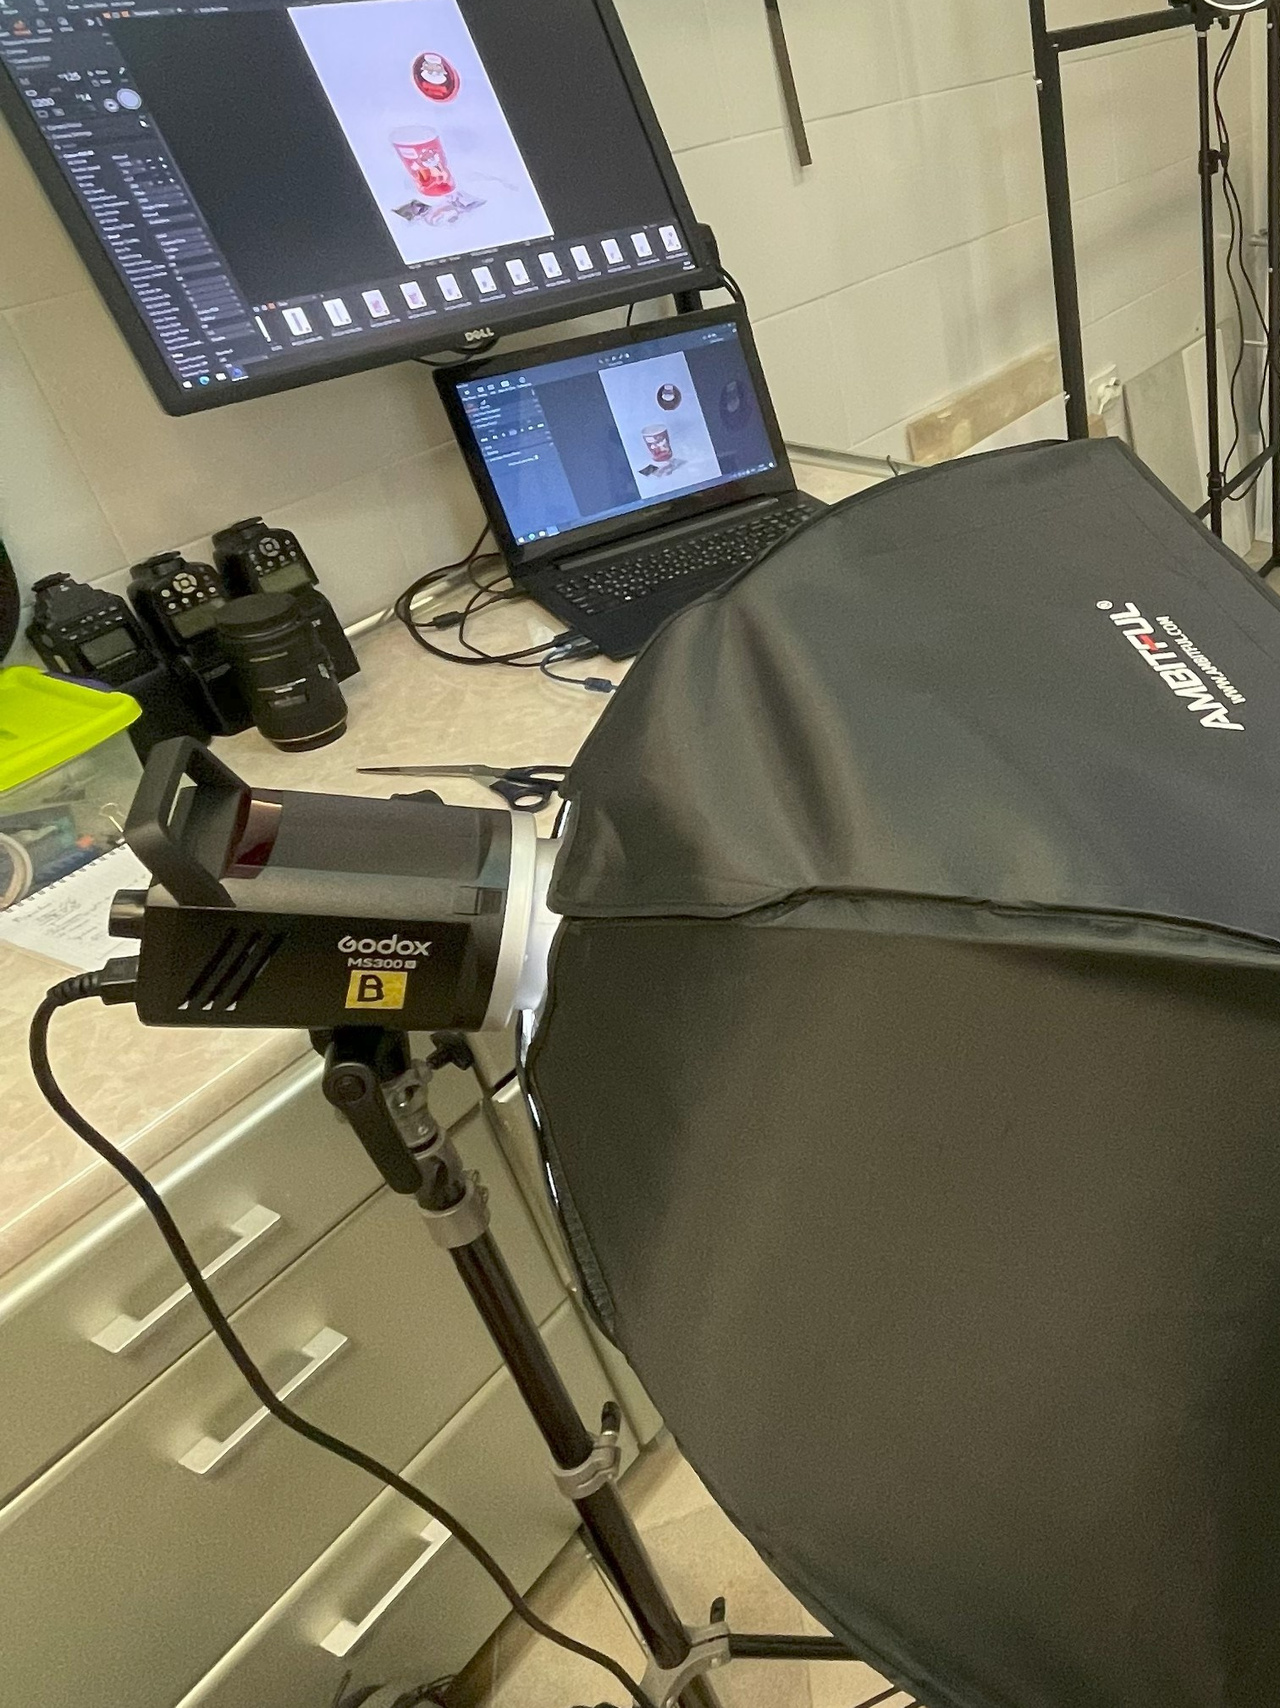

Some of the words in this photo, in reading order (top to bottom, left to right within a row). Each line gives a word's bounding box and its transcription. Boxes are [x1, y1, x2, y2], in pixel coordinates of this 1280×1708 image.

[464, 327, 495, 341] DELL
[1109, 602, 1246, 732] AMBITFUL
[1155, 615, 1247, 705] WWW.AMBITFUL.COM
[337, 933, 433, 956] Godox
[357, 974, 385, 1002] B
